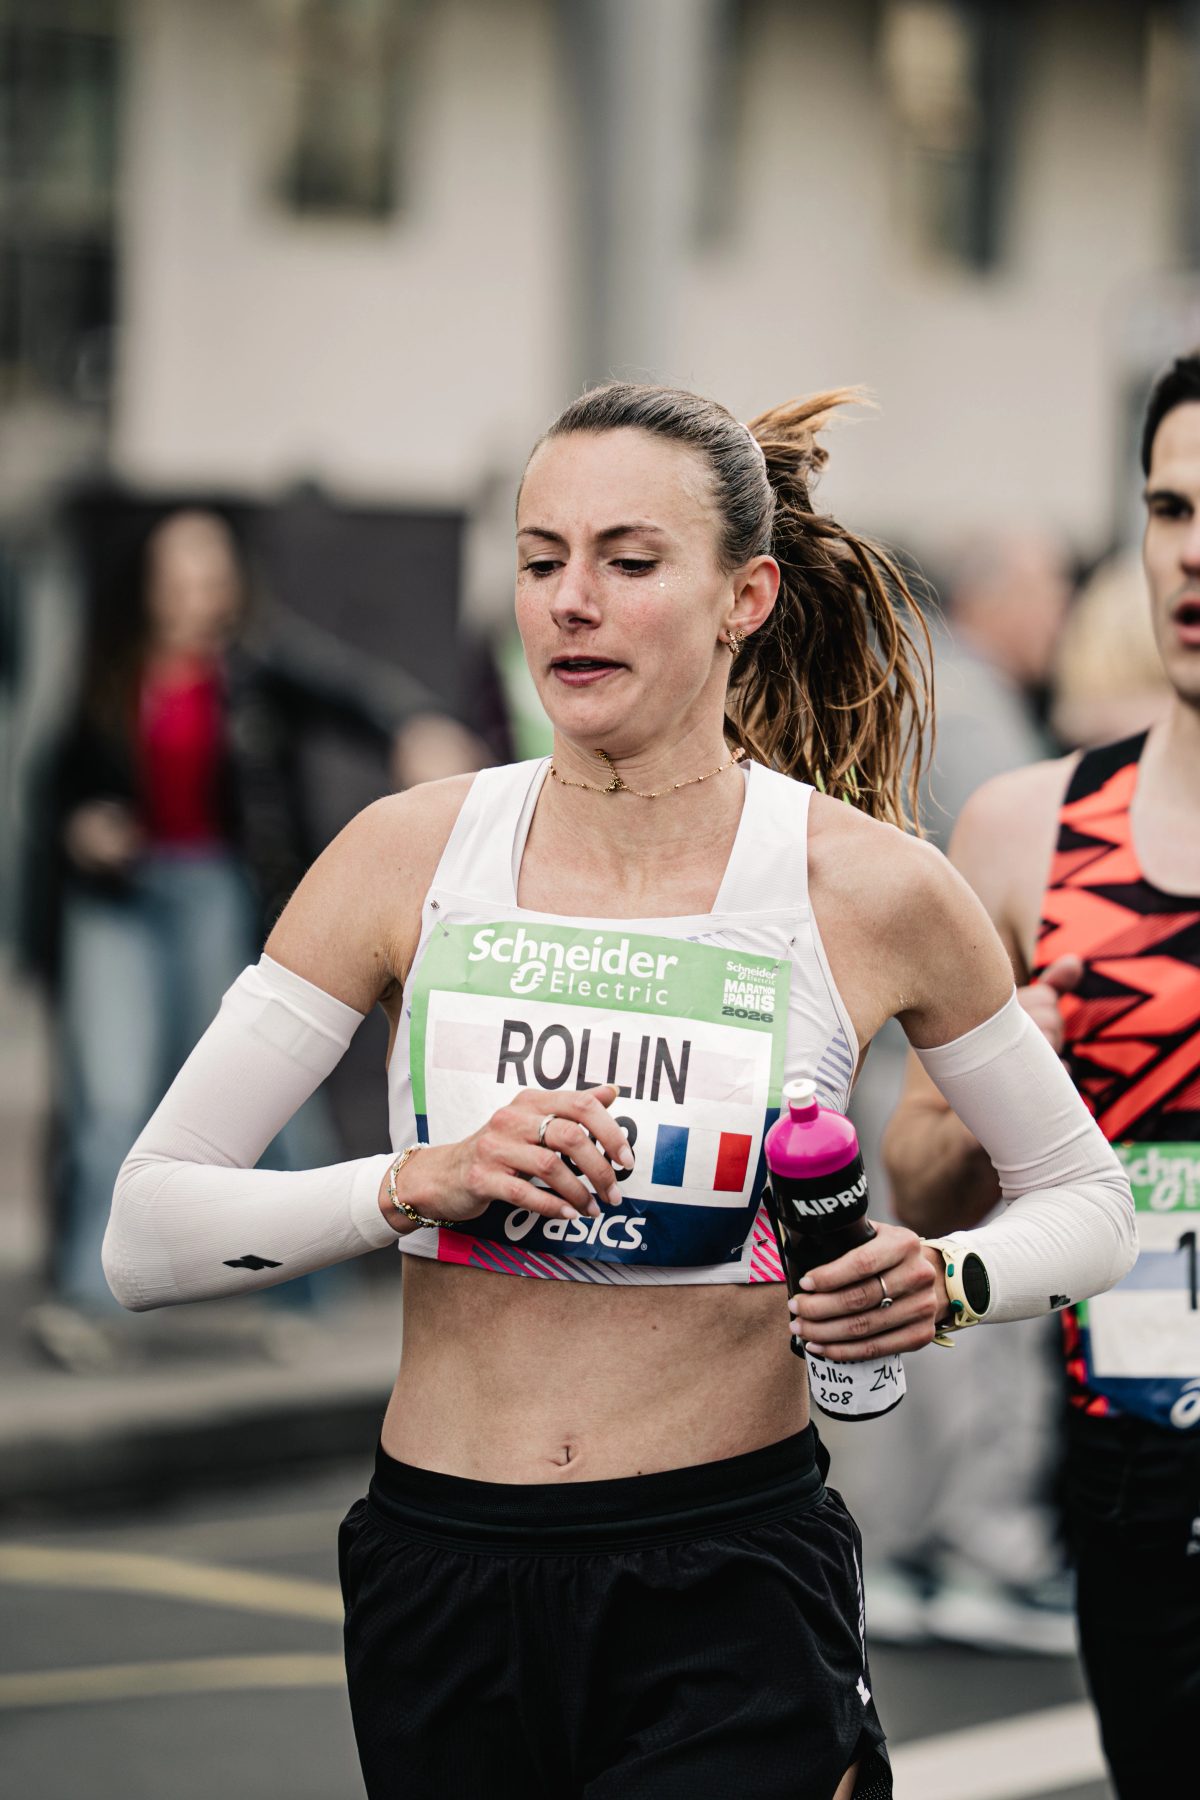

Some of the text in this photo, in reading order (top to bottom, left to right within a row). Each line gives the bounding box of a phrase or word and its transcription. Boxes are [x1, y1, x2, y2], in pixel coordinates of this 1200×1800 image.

[468, 929, 678, 980] Schneider
[726, 961, 776, 979] Schneider
[550, 971, 669, 1005] Electric
[724, 979, 775, 995] MARATHON
[728, 992, 775, 1012] PARIS
[722, 1006, 774, 1023] 2026
[496, 1019, 692, 1105] ROLLIN
[820, 1387, 853, 1405] 208
